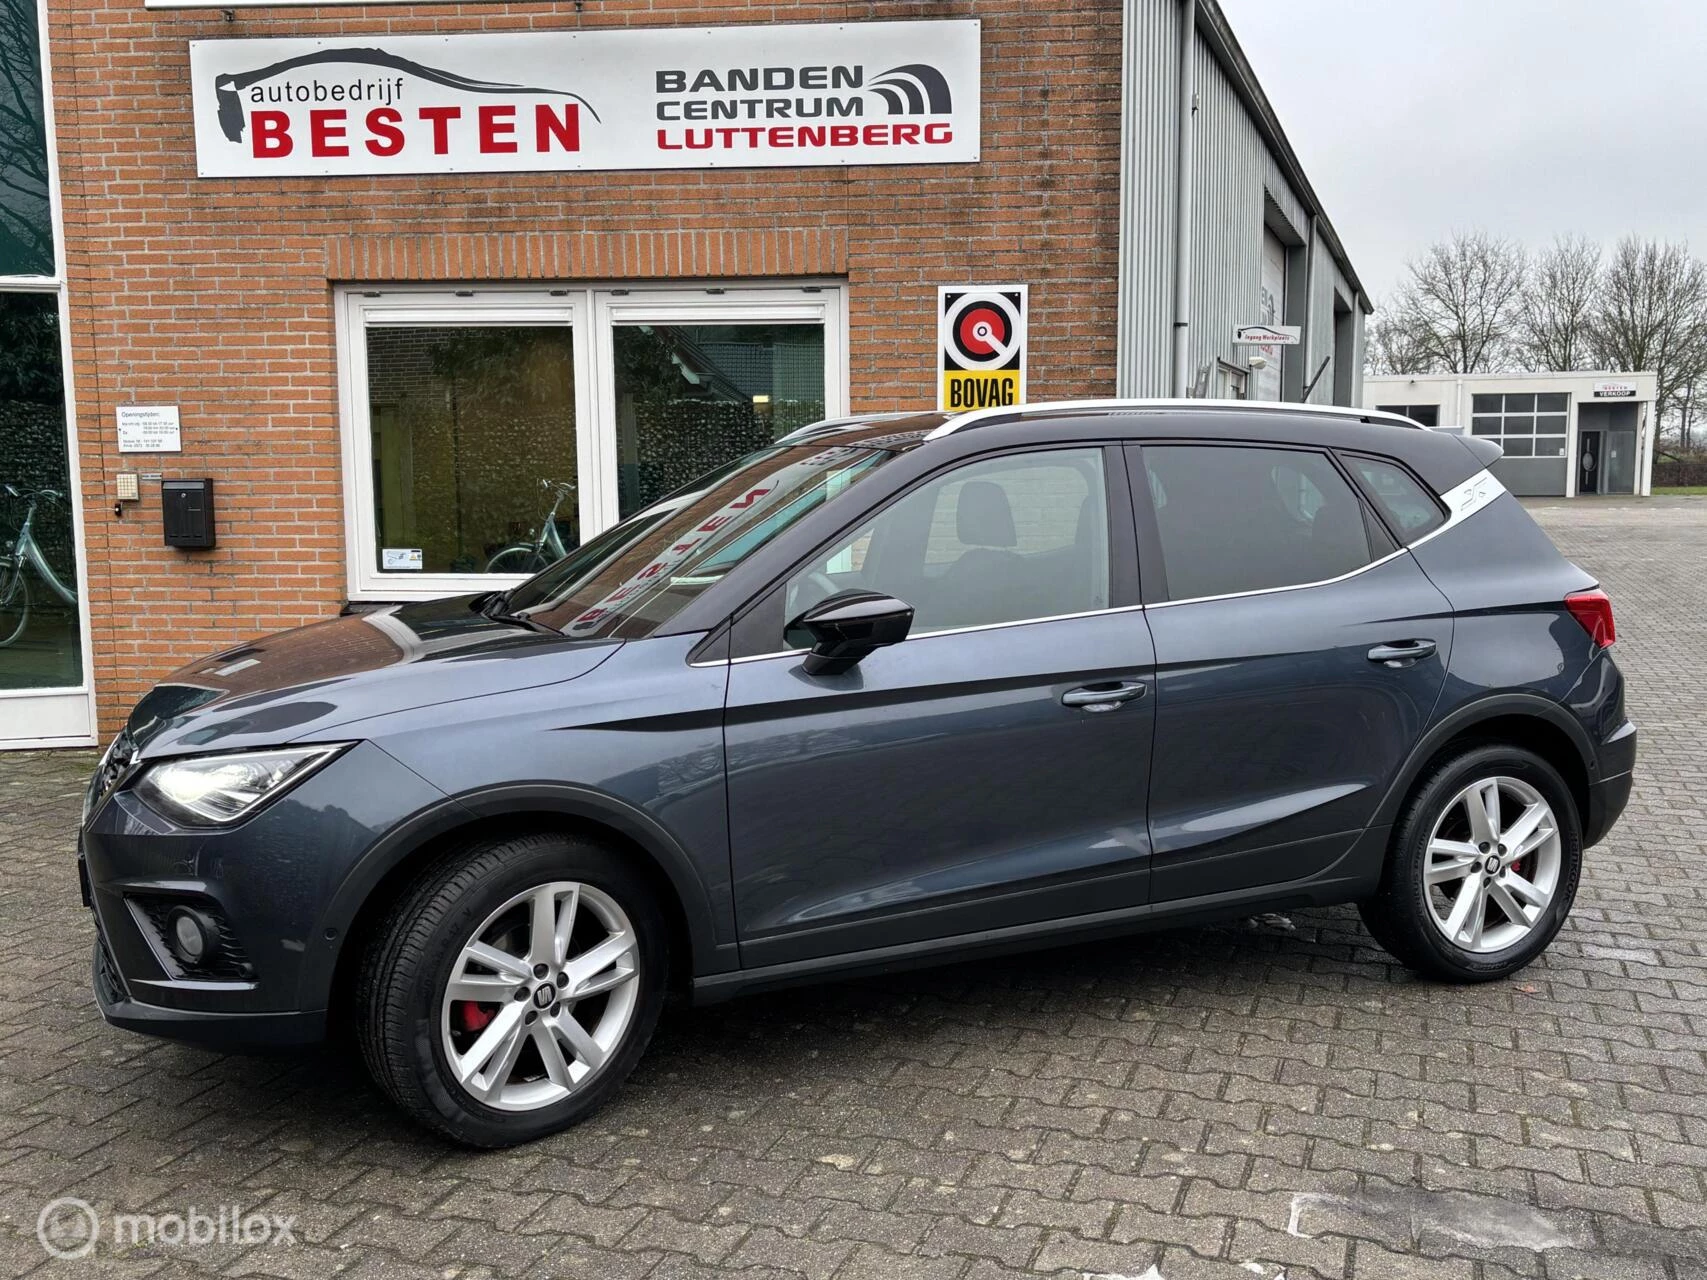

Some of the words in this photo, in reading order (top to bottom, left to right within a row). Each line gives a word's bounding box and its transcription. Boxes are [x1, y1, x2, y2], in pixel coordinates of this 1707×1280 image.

[250, 76, 404, 106] autobedrijf
[656, 65, 863, 94] BANDEN
[656, 96, 863, 121] CENTRUM
[250, 103, 581, 159] BESTEN
[657, 122, 953, 151] LUTTENBERG
[950, 377, 1014, 408] BOVAG
